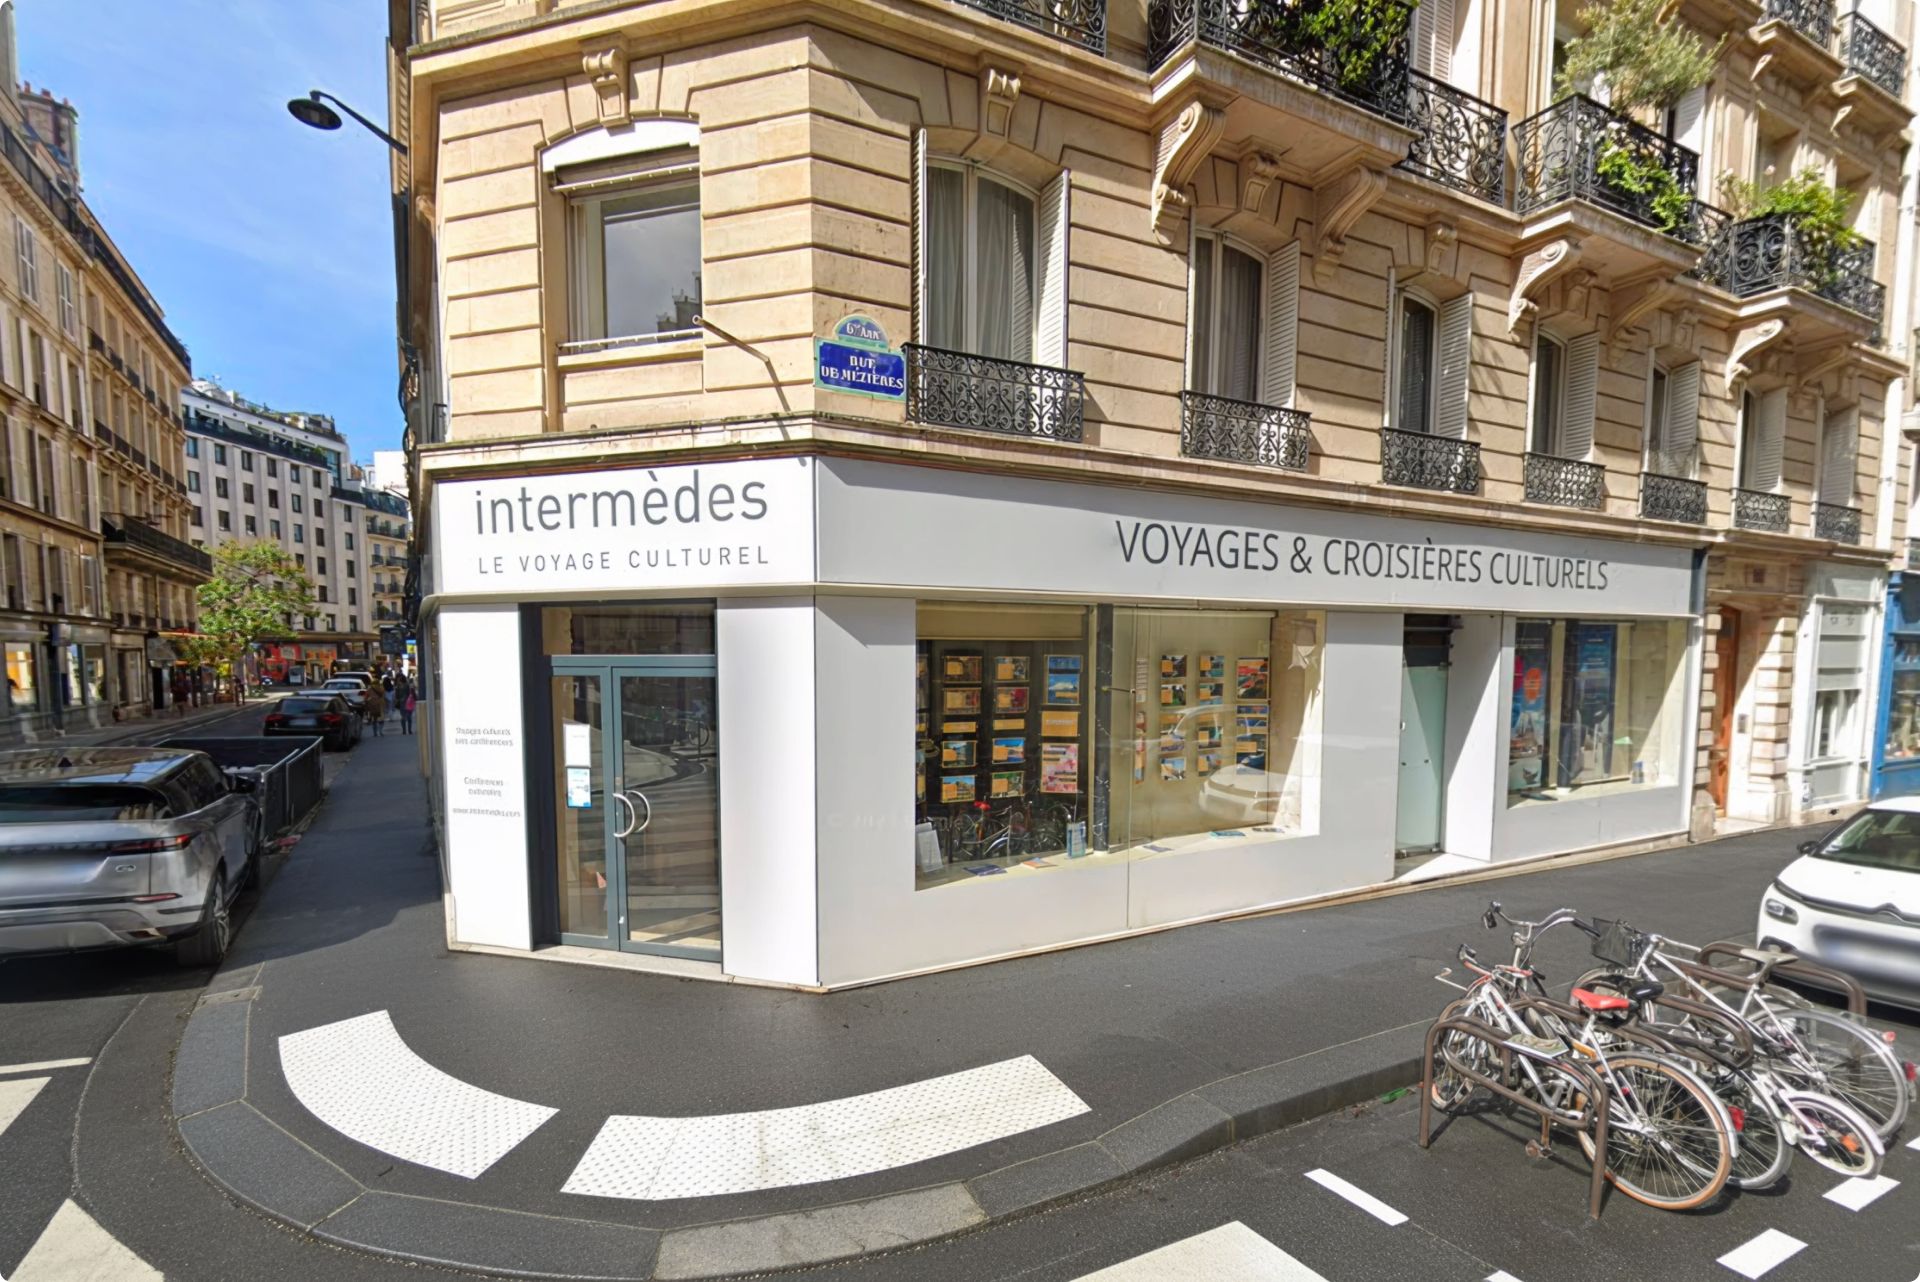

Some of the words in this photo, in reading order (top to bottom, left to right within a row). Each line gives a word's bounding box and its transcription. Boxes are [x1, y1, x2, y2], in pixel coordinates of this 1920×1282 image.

[821, 365, 839, 379] DE
[475, 469, 768, 535] intermèdes
[479, 557, 504, 575] LE
[519, 551, 611, 573] VOYAGE
[628, 545, 769, 569] CULTUREL
[1115, 520, 1279, 572] VOYAGES
[1290, 536, 1312, 574] &
[1323, 537, 1482, 583] CROISIÈRES
[1490, 552, 1608, 591] CULTURELS
